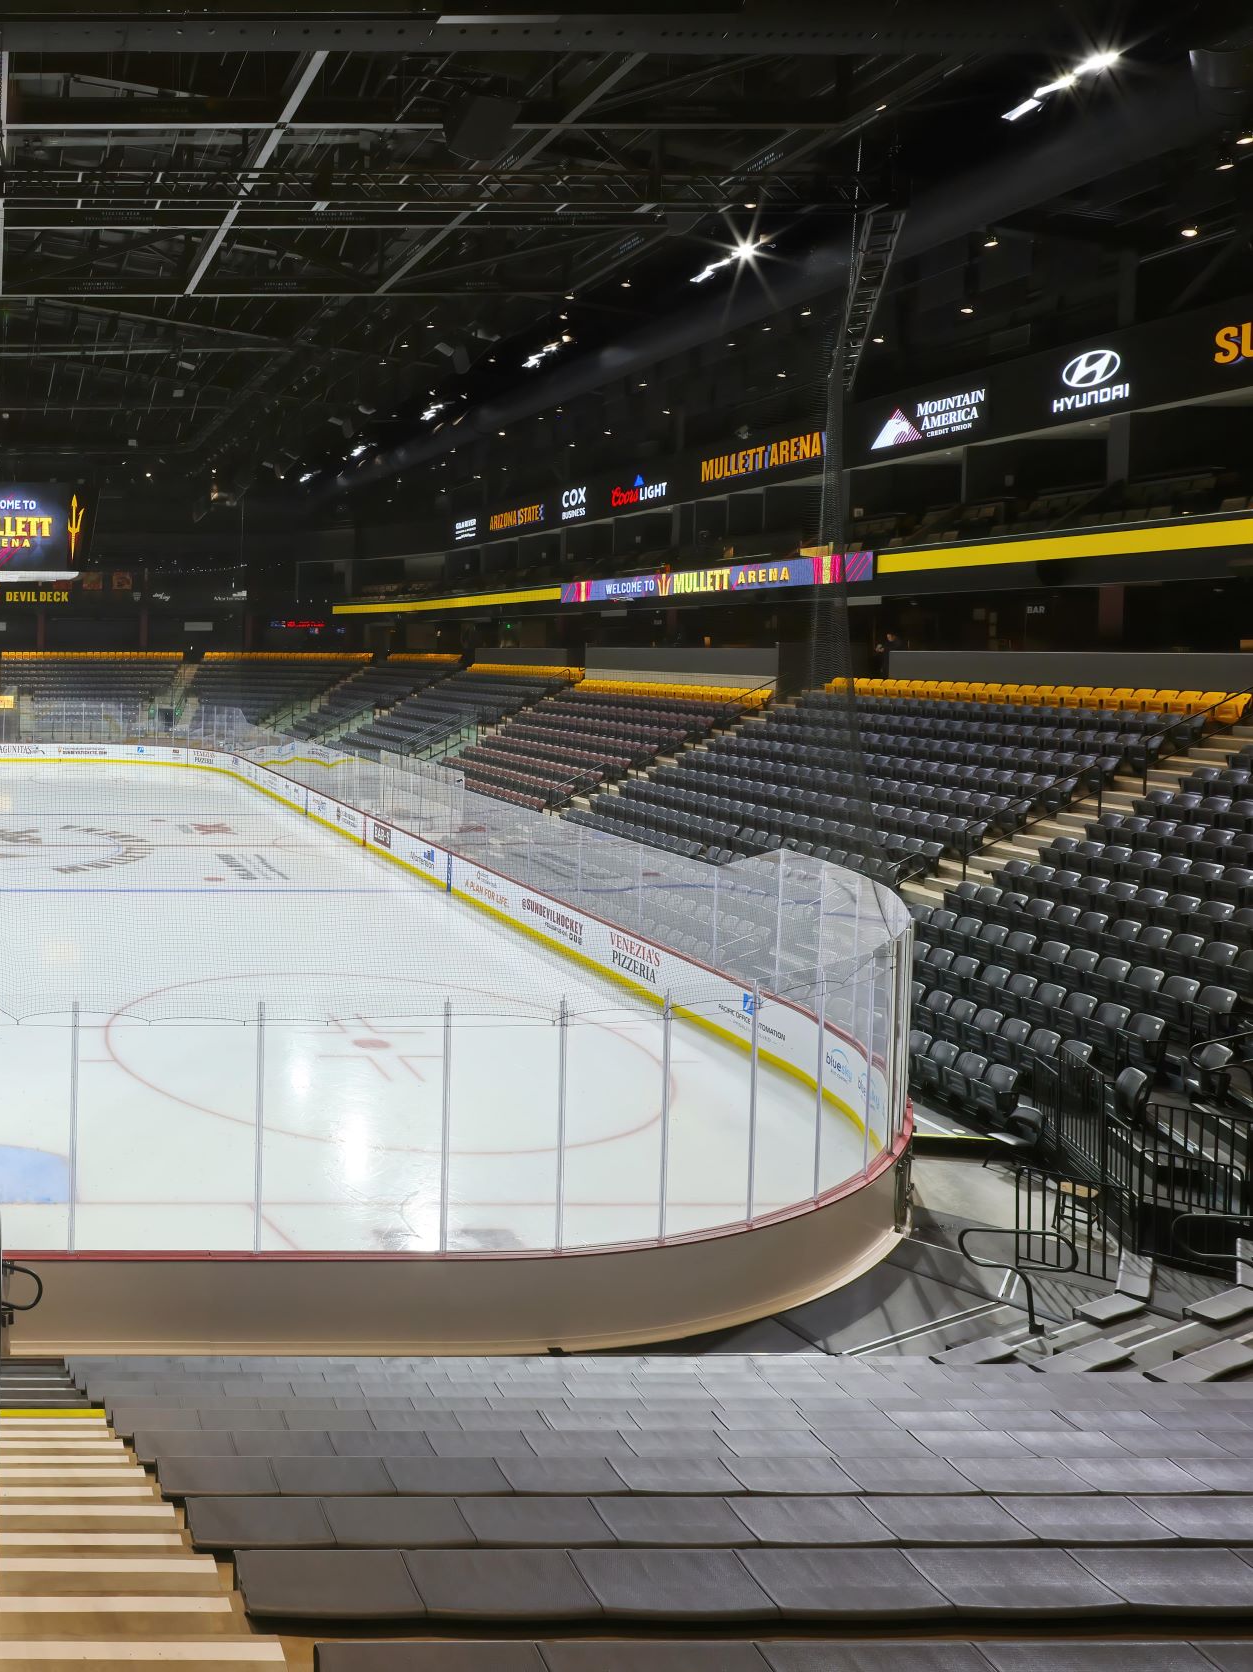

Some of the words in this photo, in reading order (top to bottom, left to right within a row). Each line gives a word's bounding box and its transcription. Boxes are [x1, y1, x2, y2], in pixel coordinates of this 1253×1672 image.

[916, 388, 986, 418] MOUNTAIN
[1053, 382, 1130, 414] HYUNDAI
[921, 407, 979, 431] AMERICA
[926, 427, 950, 438] CREDIT
[951, 422, 972, 433] UNION
[701, 444, 766, 483] MULLETT
[769, 431, 822, 468] ARENA
[22, 500, 36, 510] TO
[561, 486, 587, 509] COX
[611, 485, 639, 508] Coors
[639, 482, 668, 502] LIGHT
[489, 510, 517, 531] ARIZONA
[519, 504, 540, 525] STATE
[561, 506, 586, 521] BUSINESS
[605, 581, 642, 596] WELCOME
[643, 578, 655, 592] TO
[673, 568, 731, 594] MULLETT
[737, 566, 790, 584] ARENA
[5, 591, 37, 602] DEVIL
[39, 591, 69, 602] DECK
[1026, 605, 1045, 614] BAR
[610, 932, 660, 967] VENEZIA'S
[612, 949, 656, 984] PIZZERIA
[718, 1003, 735, 1016] PACIFIC
[735, 1012, 751, 1025] OFFICE
[758, 1022, 786, 1041] TOMATION
